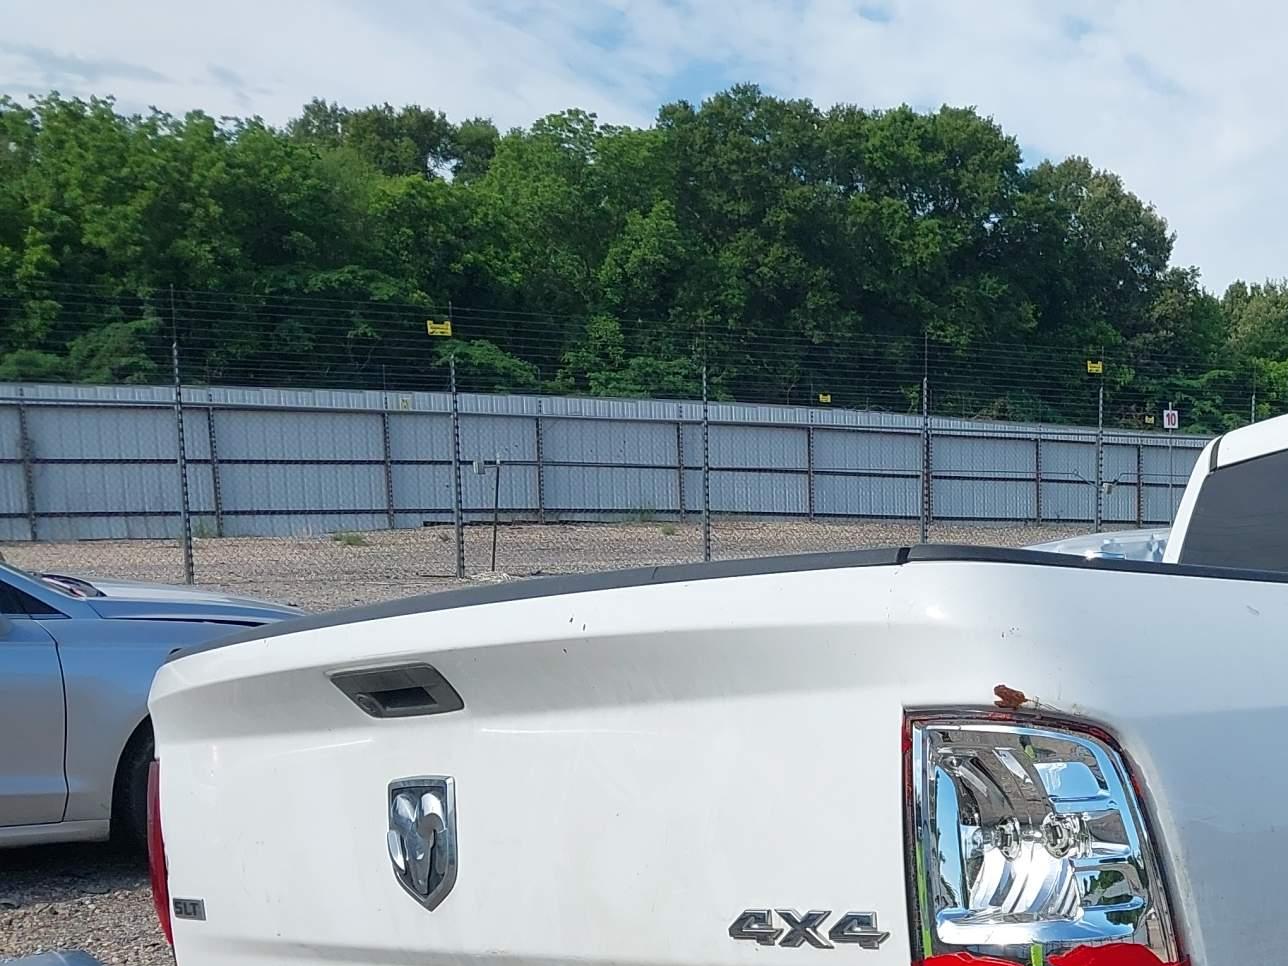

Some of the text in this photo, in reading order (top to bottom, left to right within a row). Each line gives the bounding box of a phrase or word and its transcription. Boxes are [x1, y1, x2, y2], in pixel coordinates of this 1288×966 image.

[1166, 412, 1176, 426] 10
[174, 901, 199, 916] SLT
[728, 909, 890, 950] 4X4
